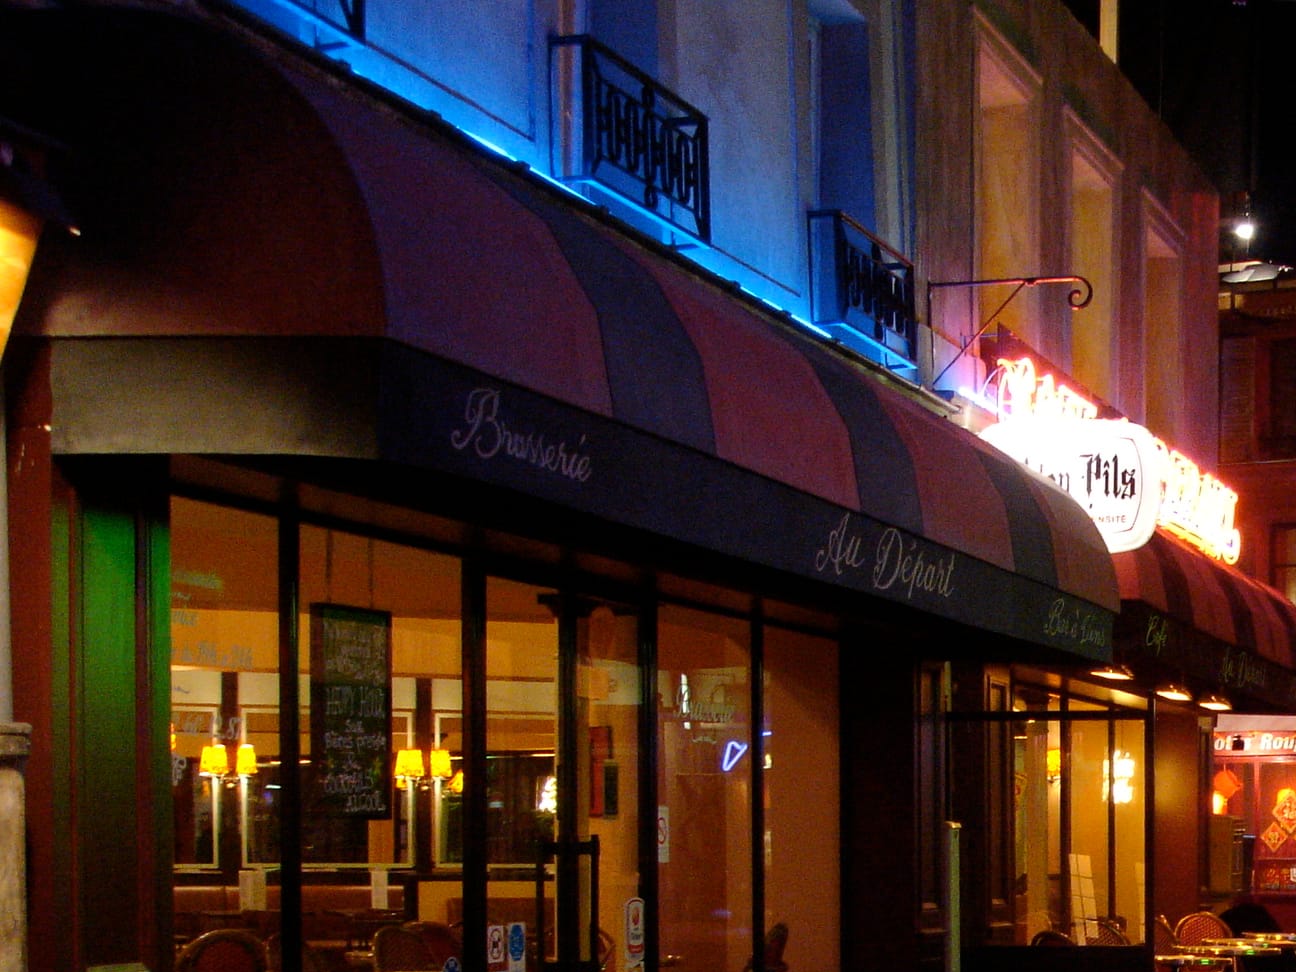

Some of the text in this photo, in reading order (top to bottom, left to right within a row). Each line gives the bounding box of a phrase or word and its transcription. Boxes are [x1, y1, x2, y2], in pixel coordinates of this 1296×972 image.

[1080, 454, 1137, 499] Pils
[815, 512, 955, 600] Au Départ
